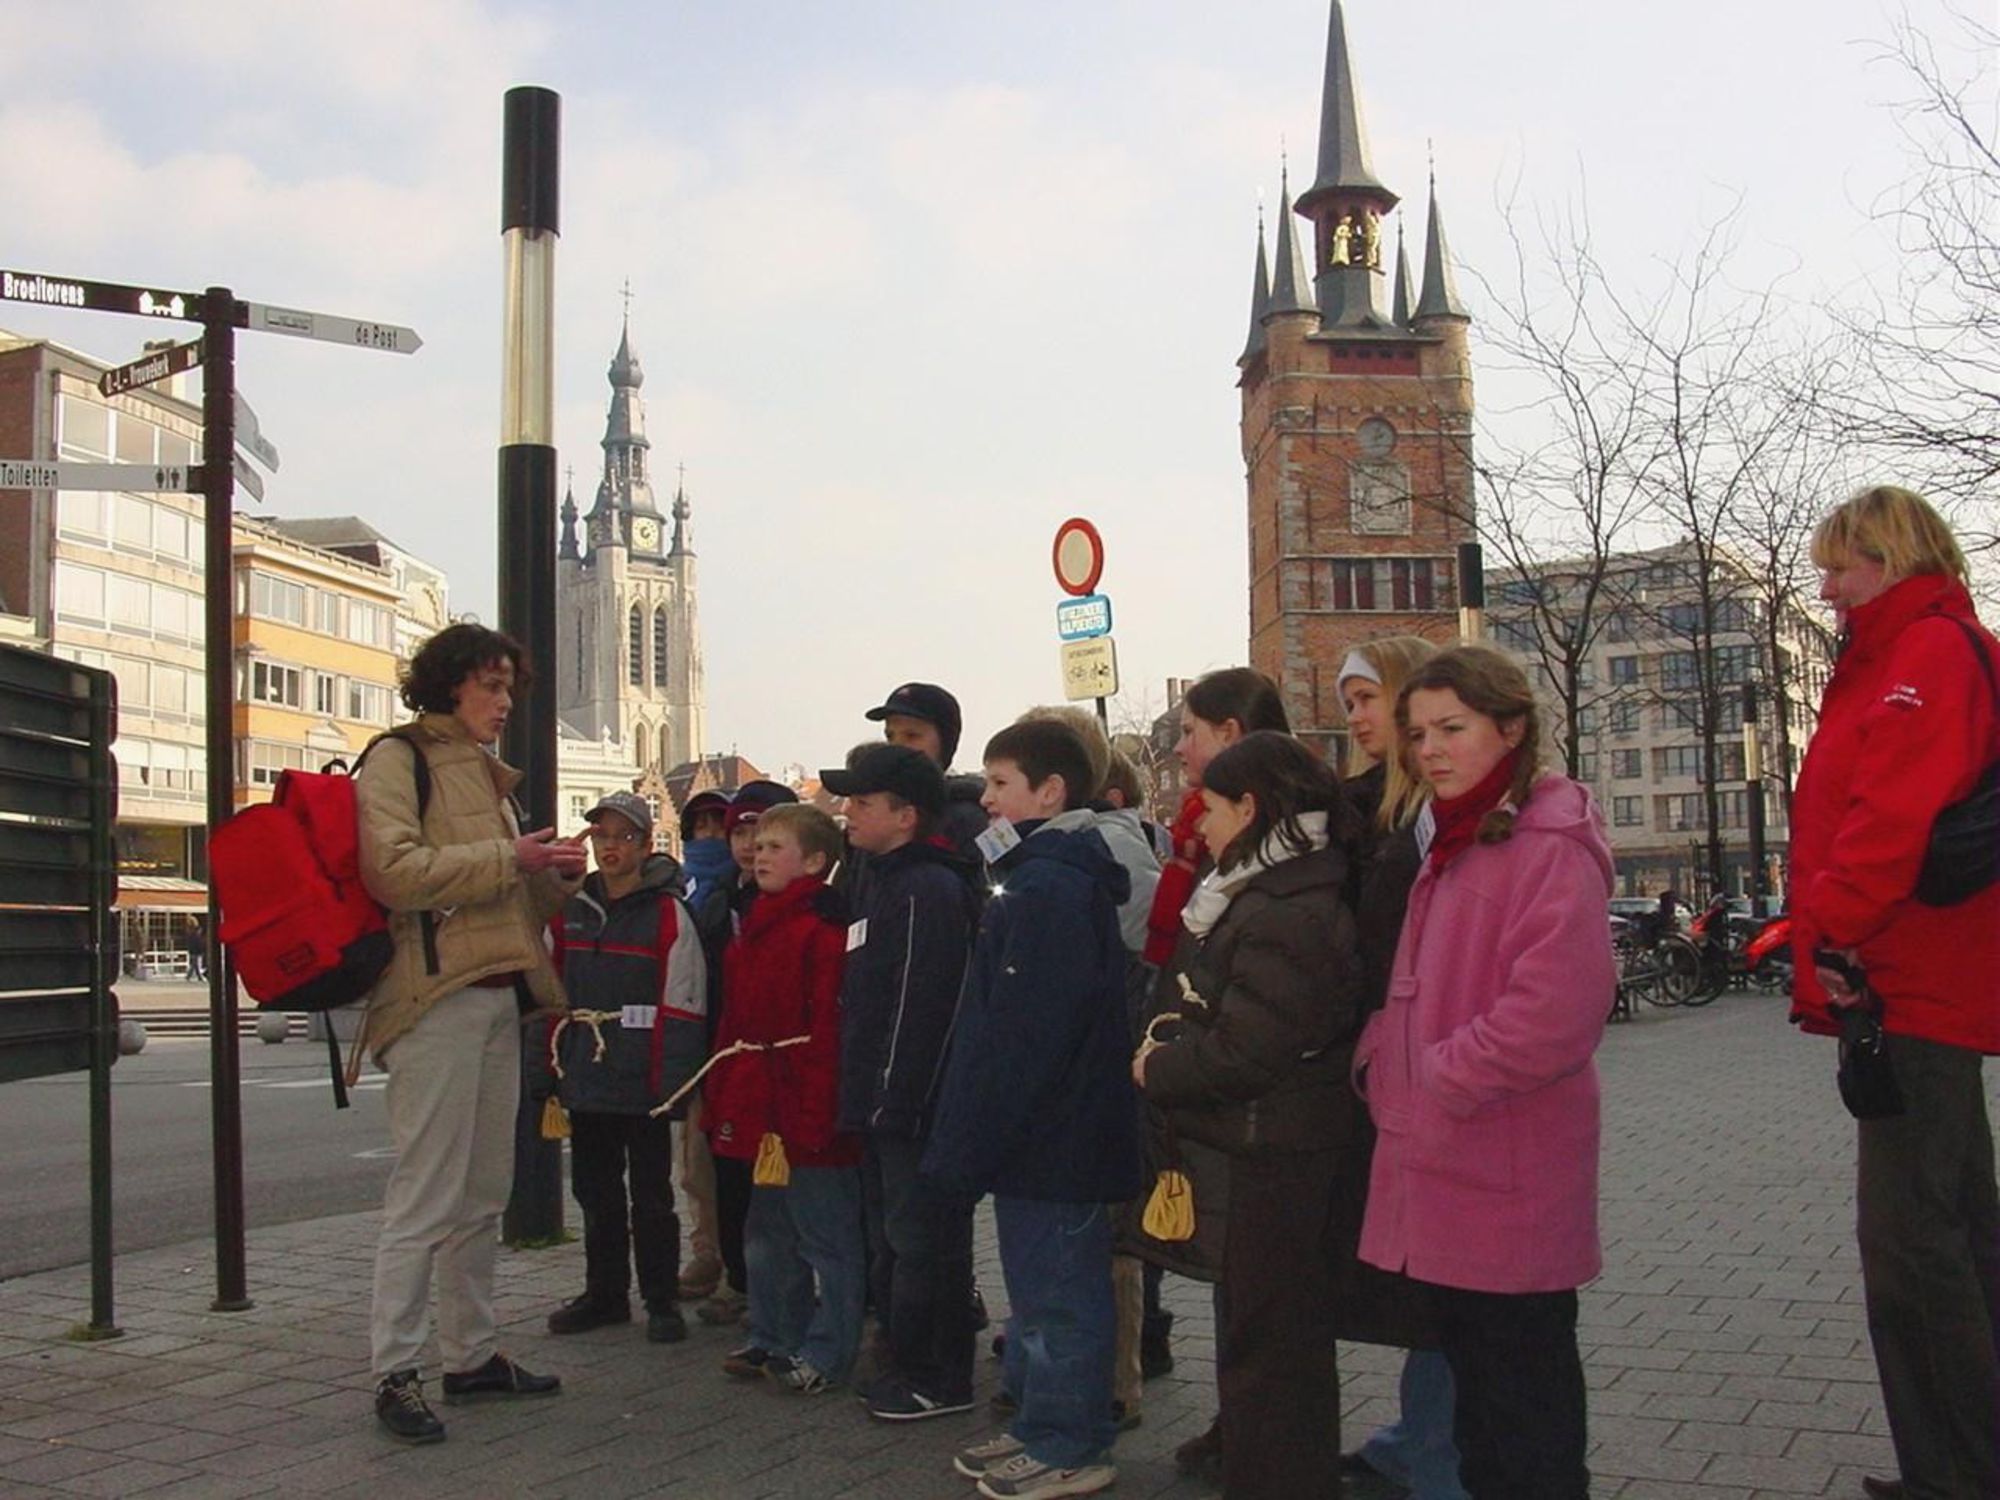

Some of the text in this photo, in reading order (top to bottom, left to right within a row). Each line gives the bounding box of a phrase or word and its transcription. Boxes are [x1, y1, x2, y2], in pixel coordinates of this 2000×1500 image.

[3, 272, 85, 306] Broeltorens
[355, 322, 397, 348] de Post
[1, 463, 58, 487] Toiletten
